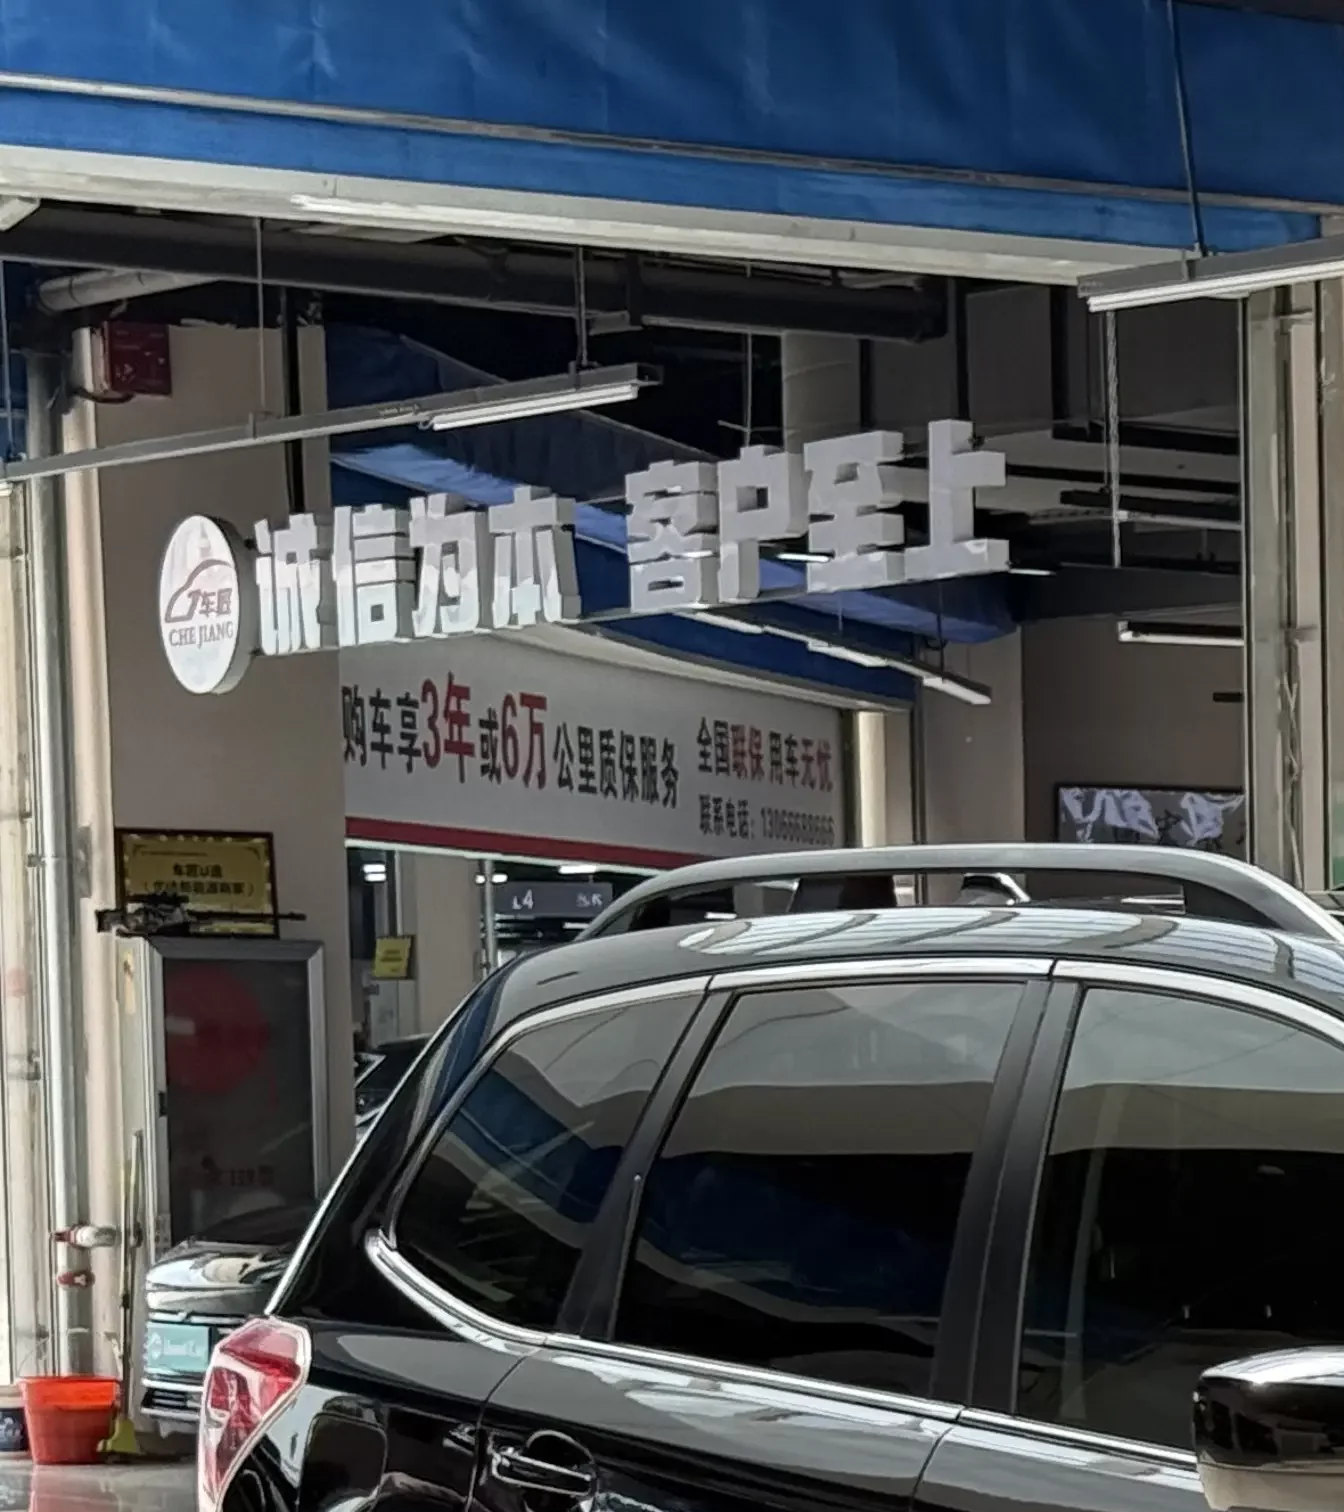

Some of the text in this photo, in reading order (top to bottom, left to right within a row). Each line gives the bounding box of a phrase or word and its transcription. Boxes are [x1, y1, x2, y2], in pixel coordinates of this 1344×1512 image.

[254, 419, 1009, 657] 诚信为本 客户至上
[169, 621, 234, 649] CHE JIANG
[697, 716, 765, 781] 全国联保
